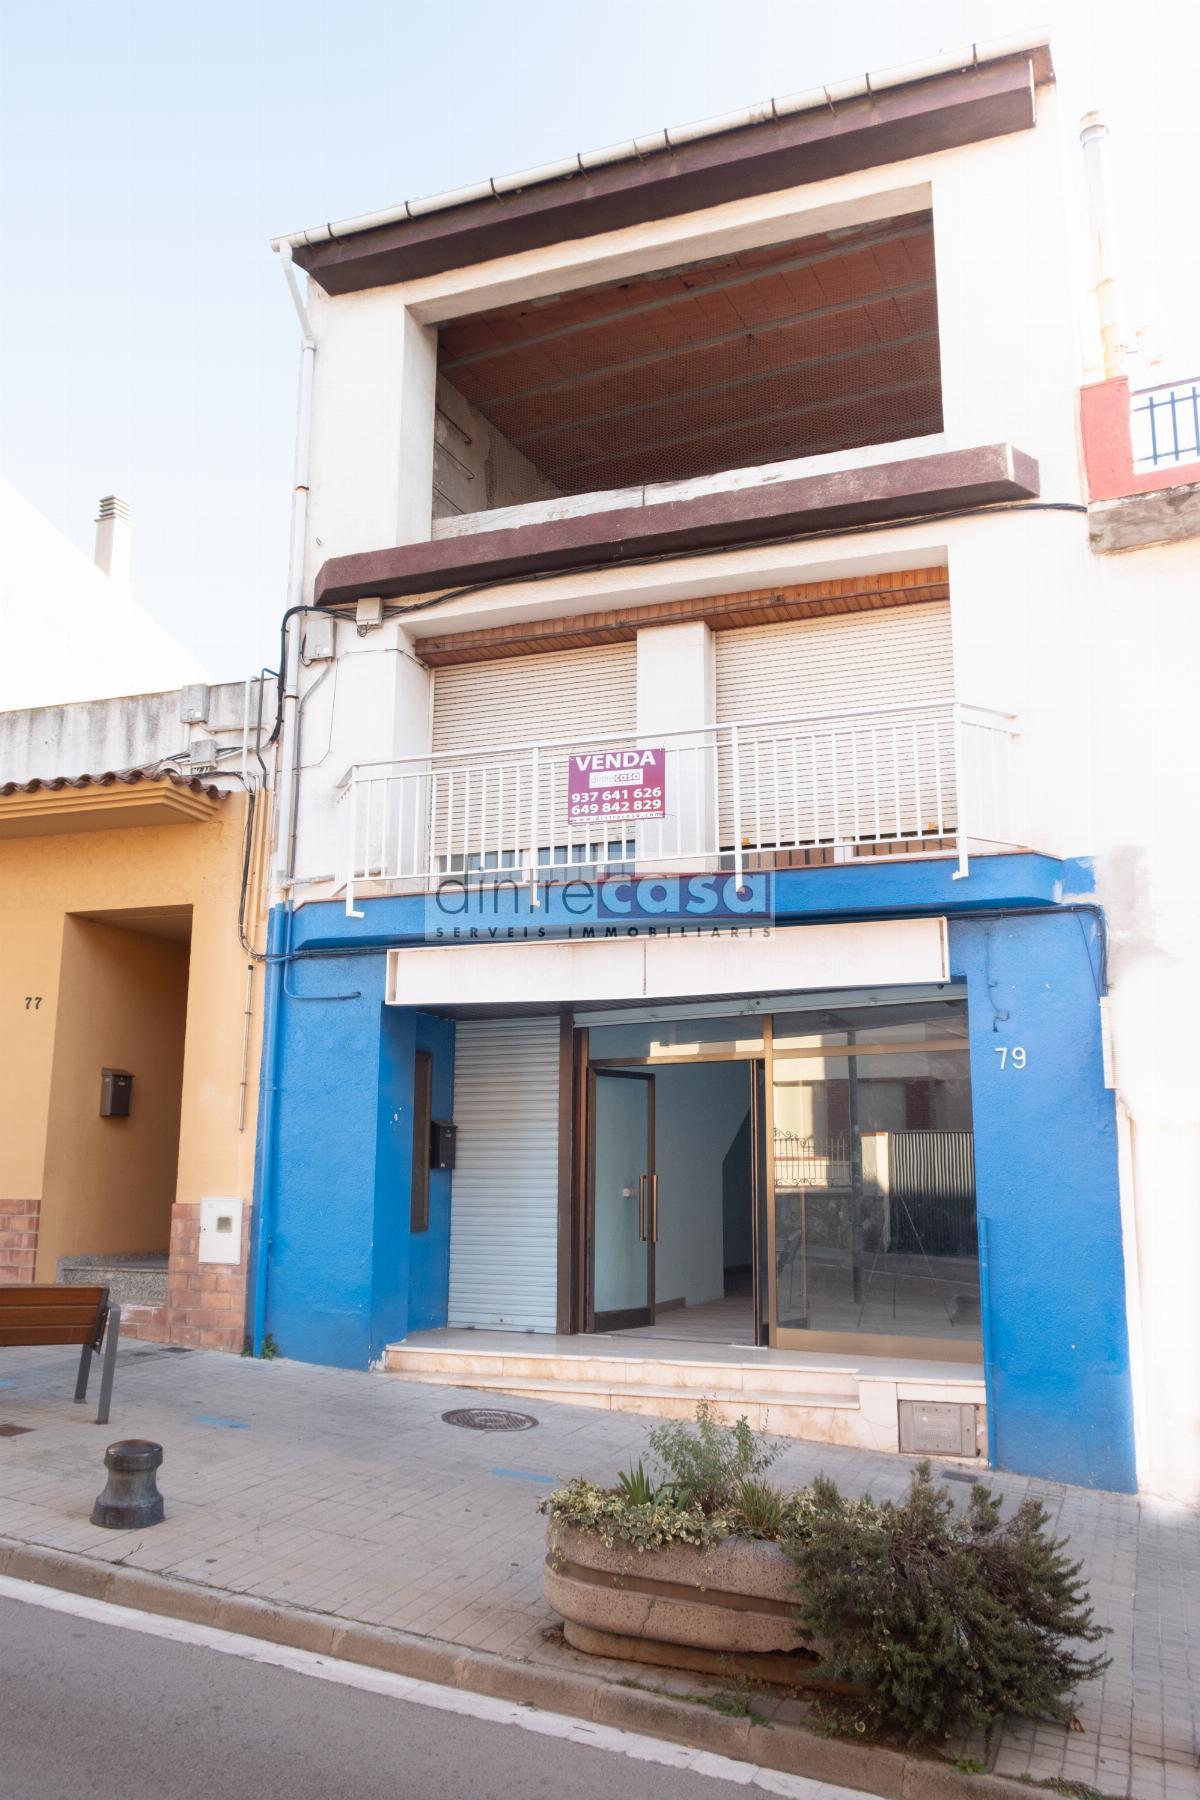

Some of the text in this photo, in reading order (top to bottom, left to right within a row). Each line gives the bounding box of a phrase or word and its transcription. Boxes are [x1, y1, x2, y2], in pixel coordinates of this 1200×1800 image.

[575, 751, 656, 771] VENDA
[571, 787, 662, 803] 937 641 626
[571, 799, 662, 815] 649 842 829
[25, 996, 42, 1010] 77
[994, 1046, 1026, 1070] 79
